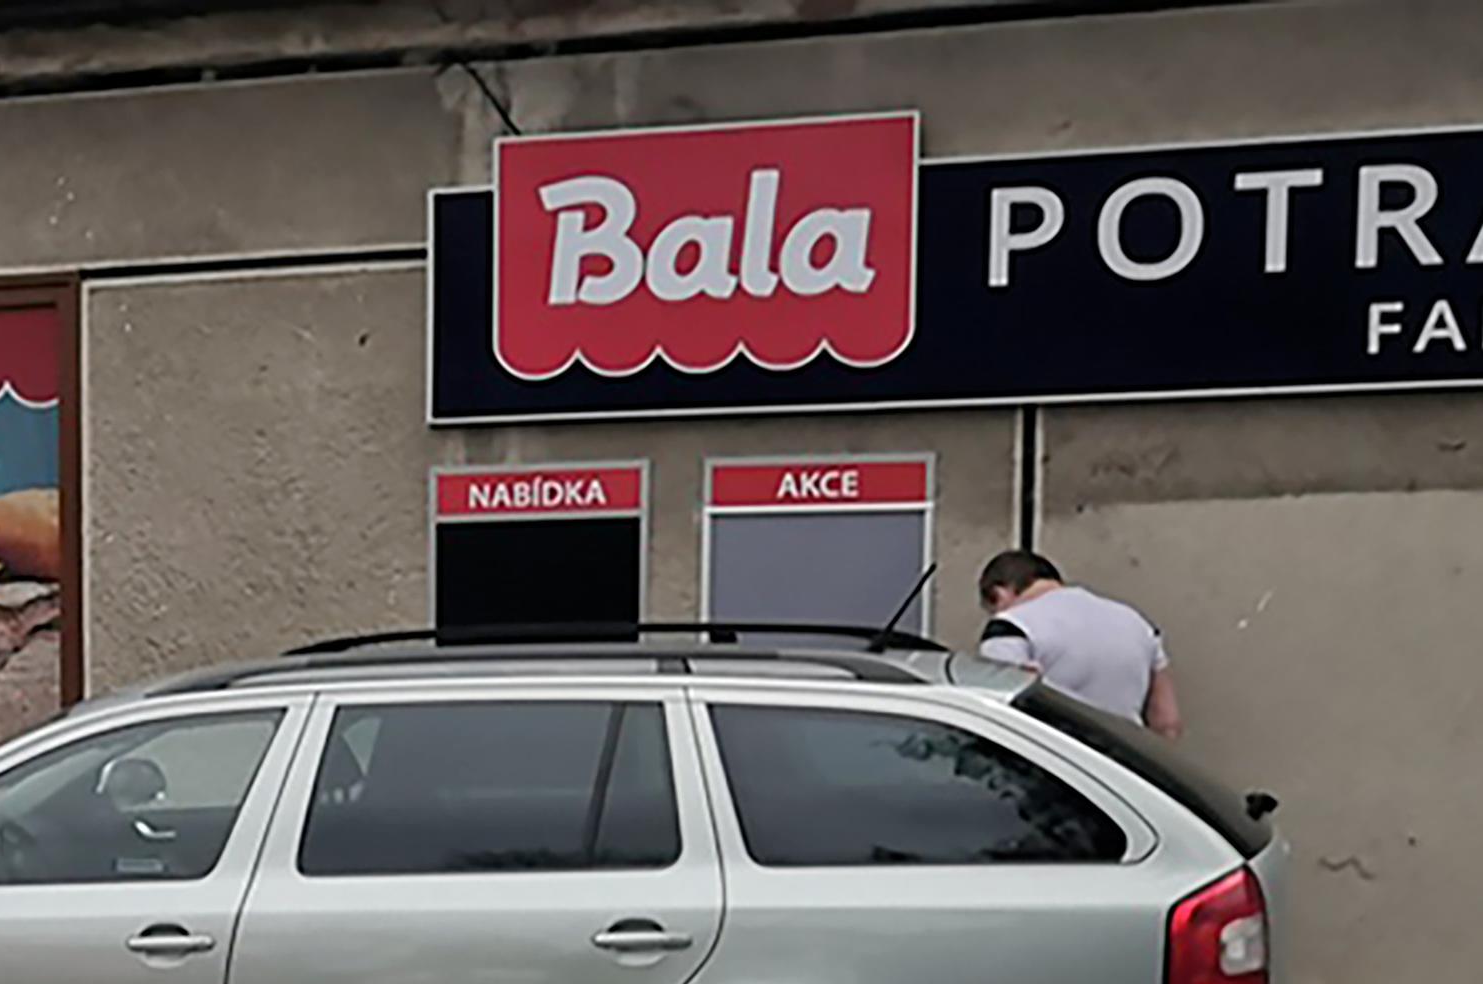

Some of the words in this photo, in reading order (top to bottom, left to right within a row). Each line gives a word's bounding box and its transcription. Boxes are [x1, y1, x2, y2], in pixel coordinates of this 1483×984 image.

[539, 168, 876, 306] Bala
[988, 163, 1483, 288] POTR
[1367, 299, 1483, 354] FA
[468, 477, 607, 508] NABÍDKA
[776, 470, 859, 499] AKCE
